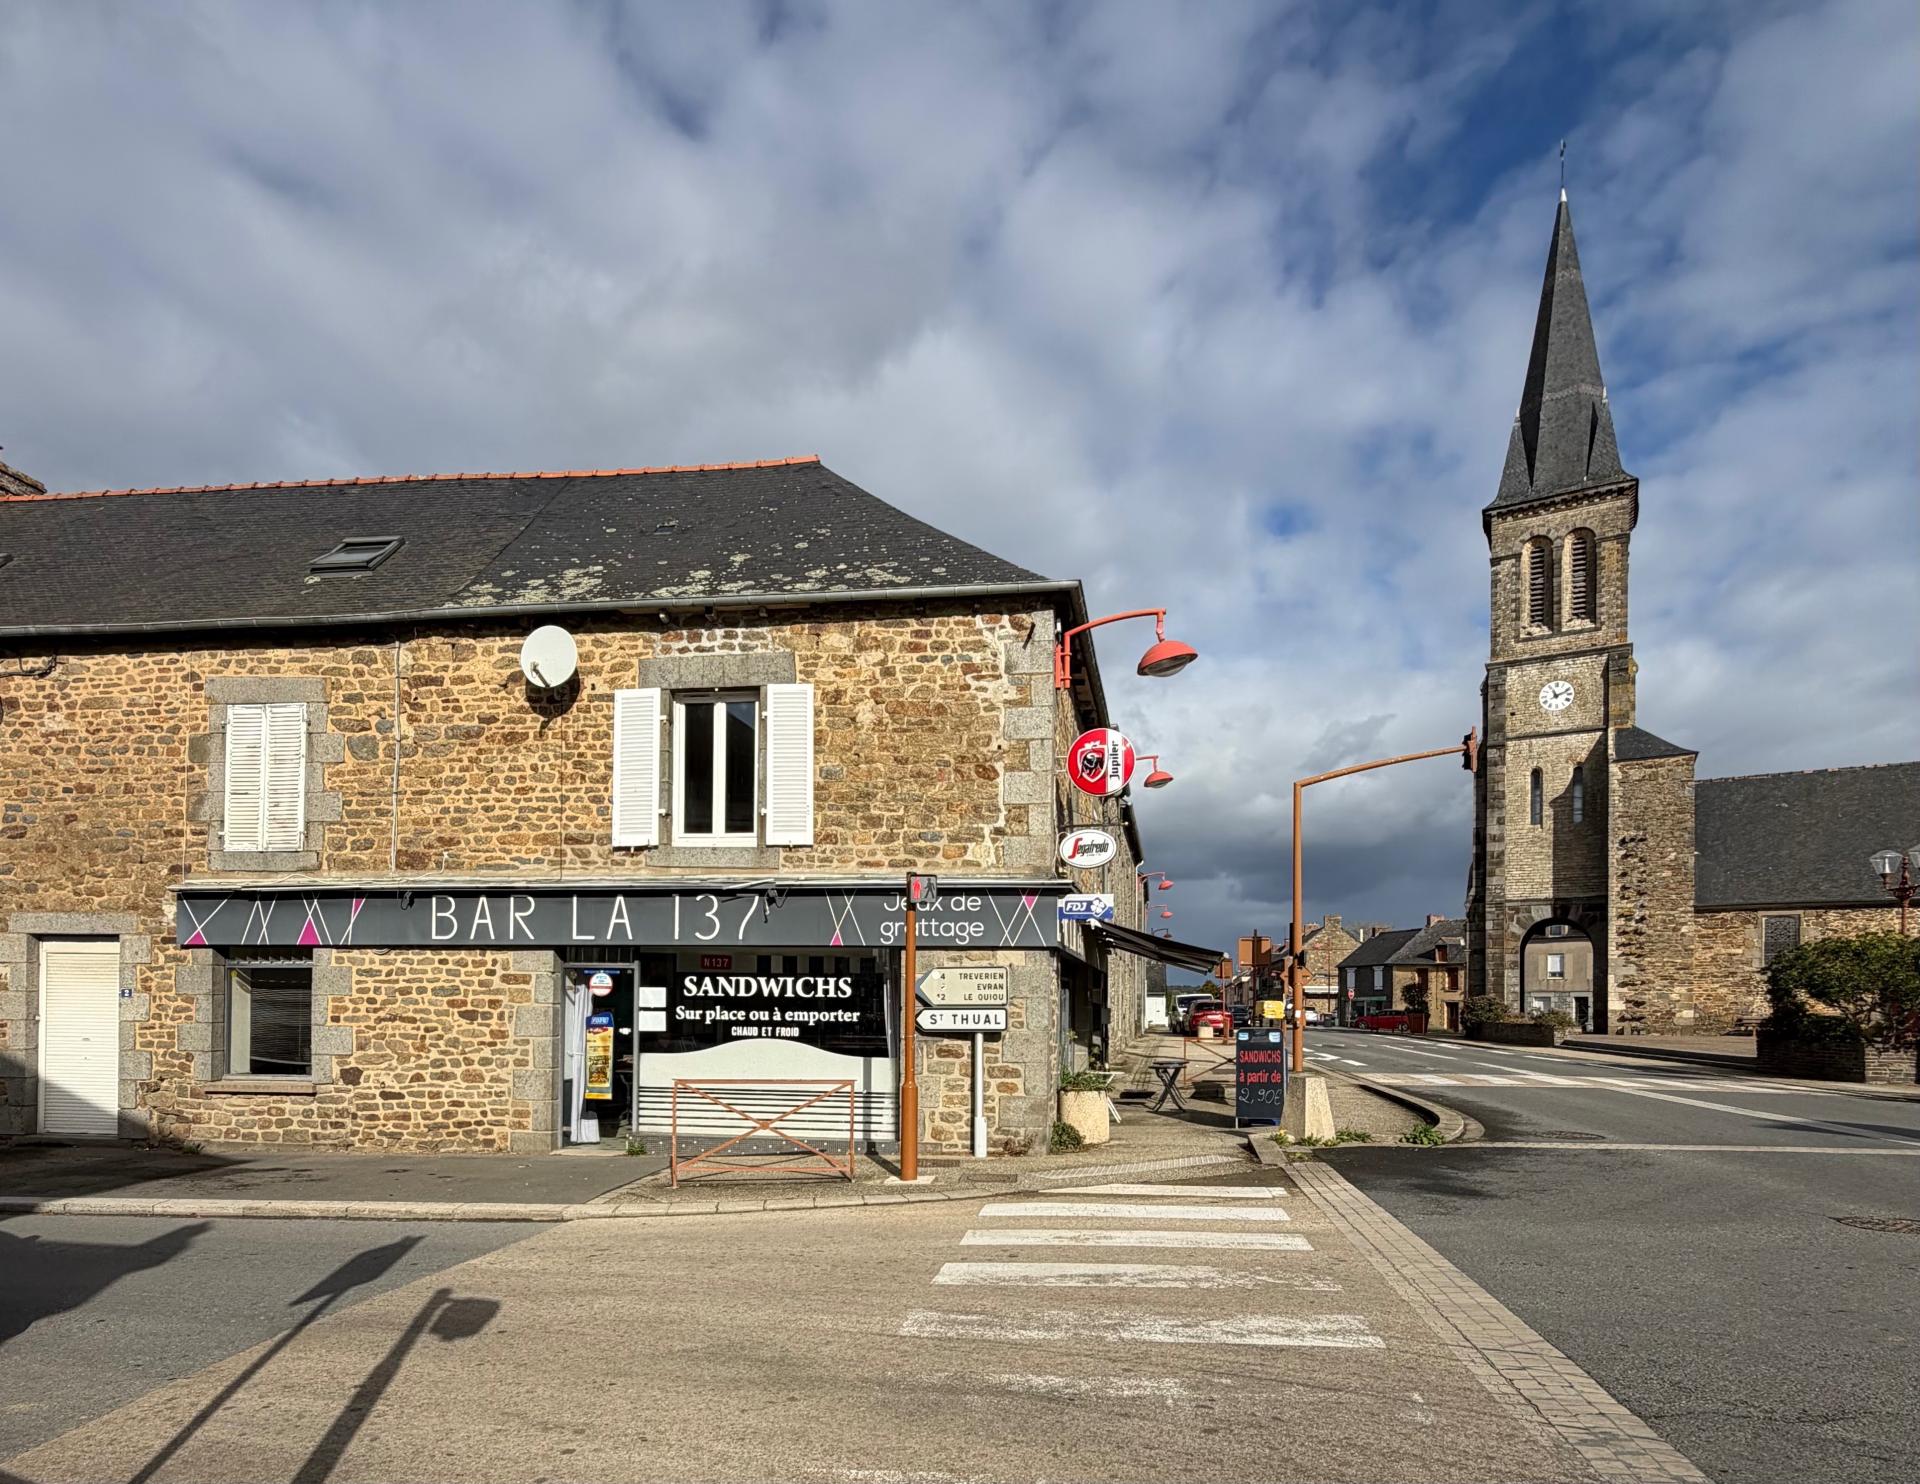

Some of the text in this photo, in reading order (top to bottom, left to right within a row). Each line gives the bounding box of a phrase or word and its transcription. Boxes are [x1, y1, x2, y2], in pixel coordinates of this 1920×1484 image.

[1109, 740, 1121, 781] Jupiler
[1067, 836, 1110, 859] Segafredo
[950, 892, 982, 912] de
[1066, 902, 1087, 911] FDJ
[431, 894, 760, 940] BAR LA 137
[683, 976, 853, 998] SANDWICHS
[977, 983, 1004, 991] EVRAN
[675, 1005, 860, 1026] Sur place ou à emporter
[951, 1014, 1002, 1025] THUAL
[731, 1026, 799, 1037] CHAUD ET FROID
[1239, 1050, 1281, 1063] SANDWICHS
[1239, 1069, 1281, 1086] à partir de
